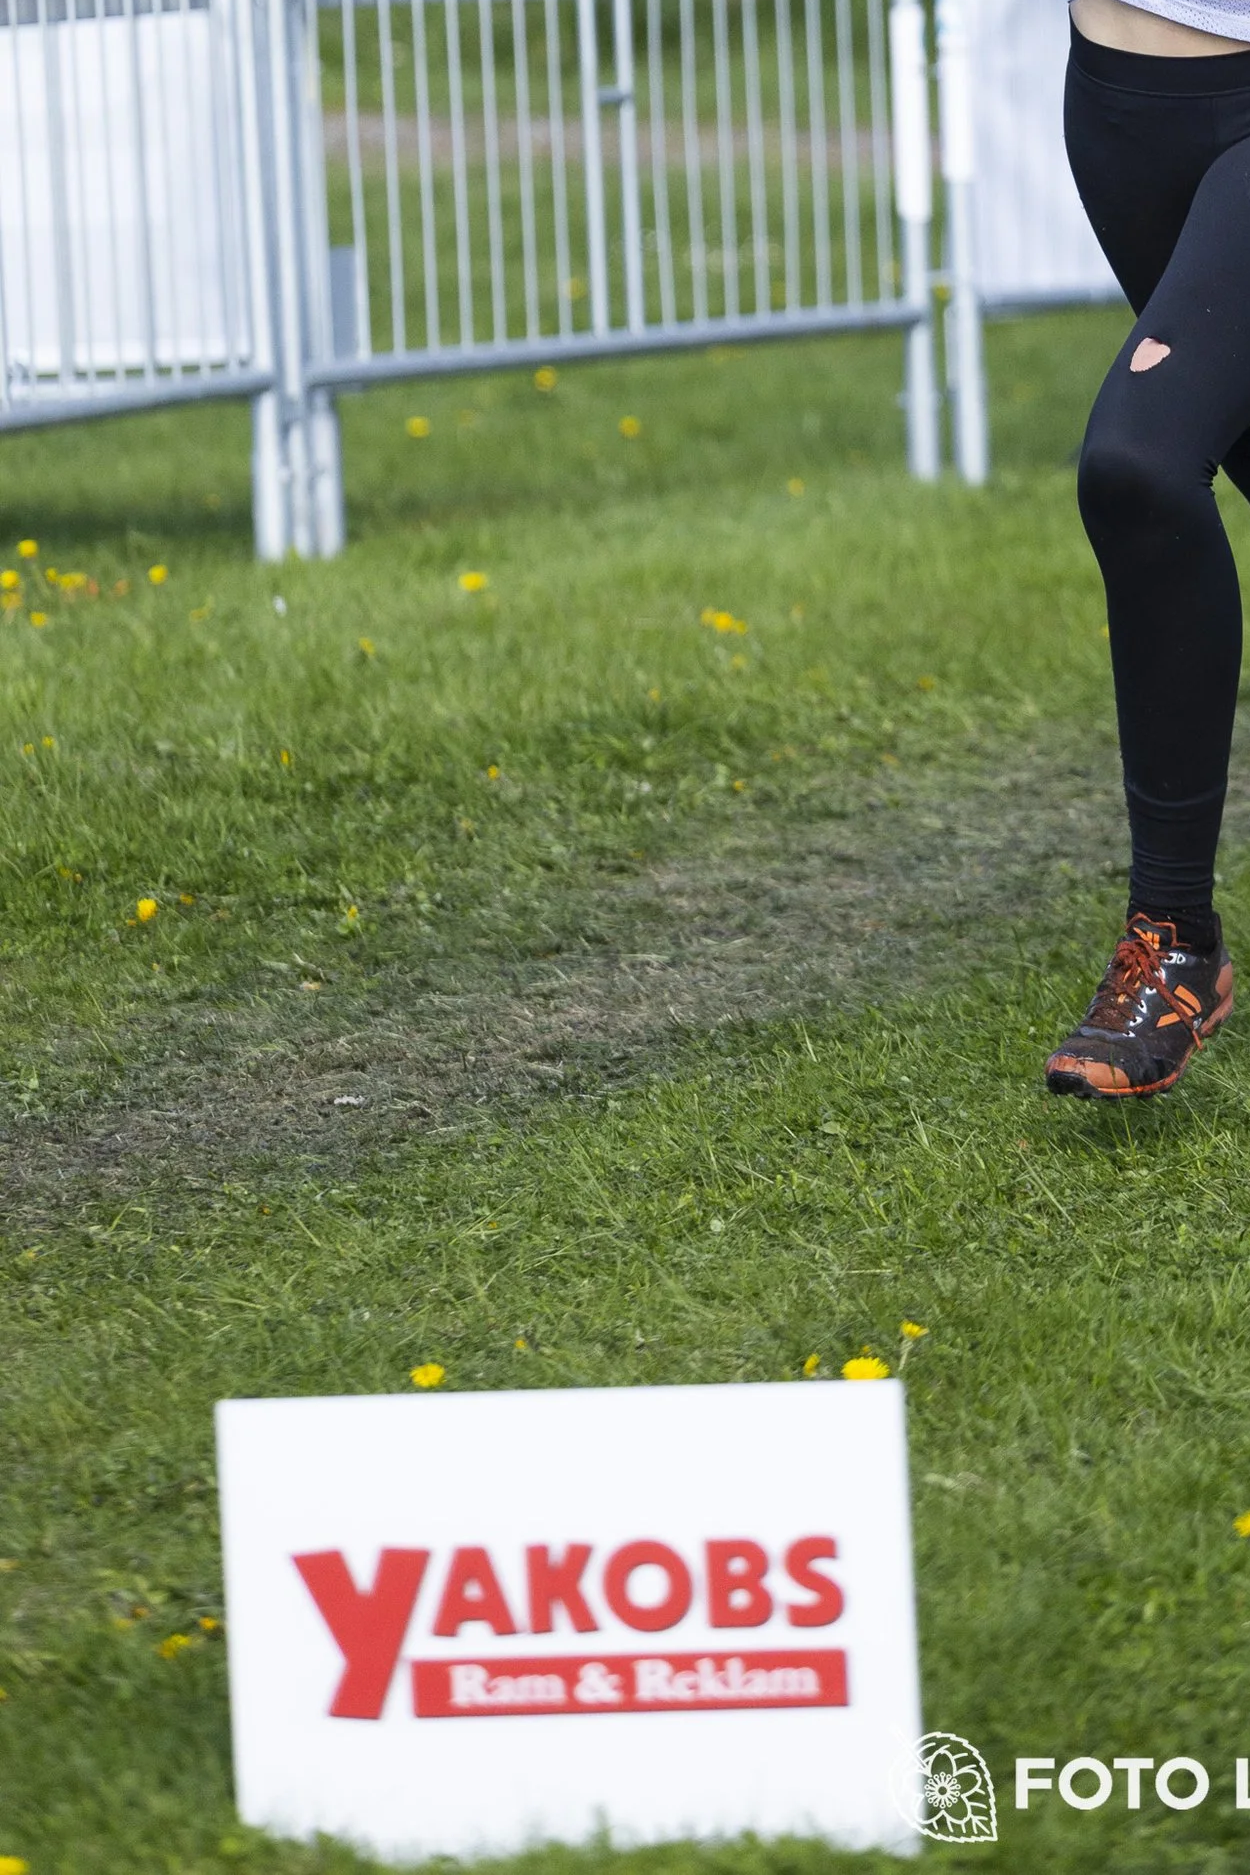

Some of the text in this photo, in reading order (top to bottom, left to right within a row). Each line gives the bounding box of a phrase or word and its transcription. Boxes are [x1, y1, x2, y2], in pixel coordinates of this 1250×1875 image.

[291, 1534, 846, 1720] YAKOBS
[449, 1657, 820, 1708] Ram & Reklam
